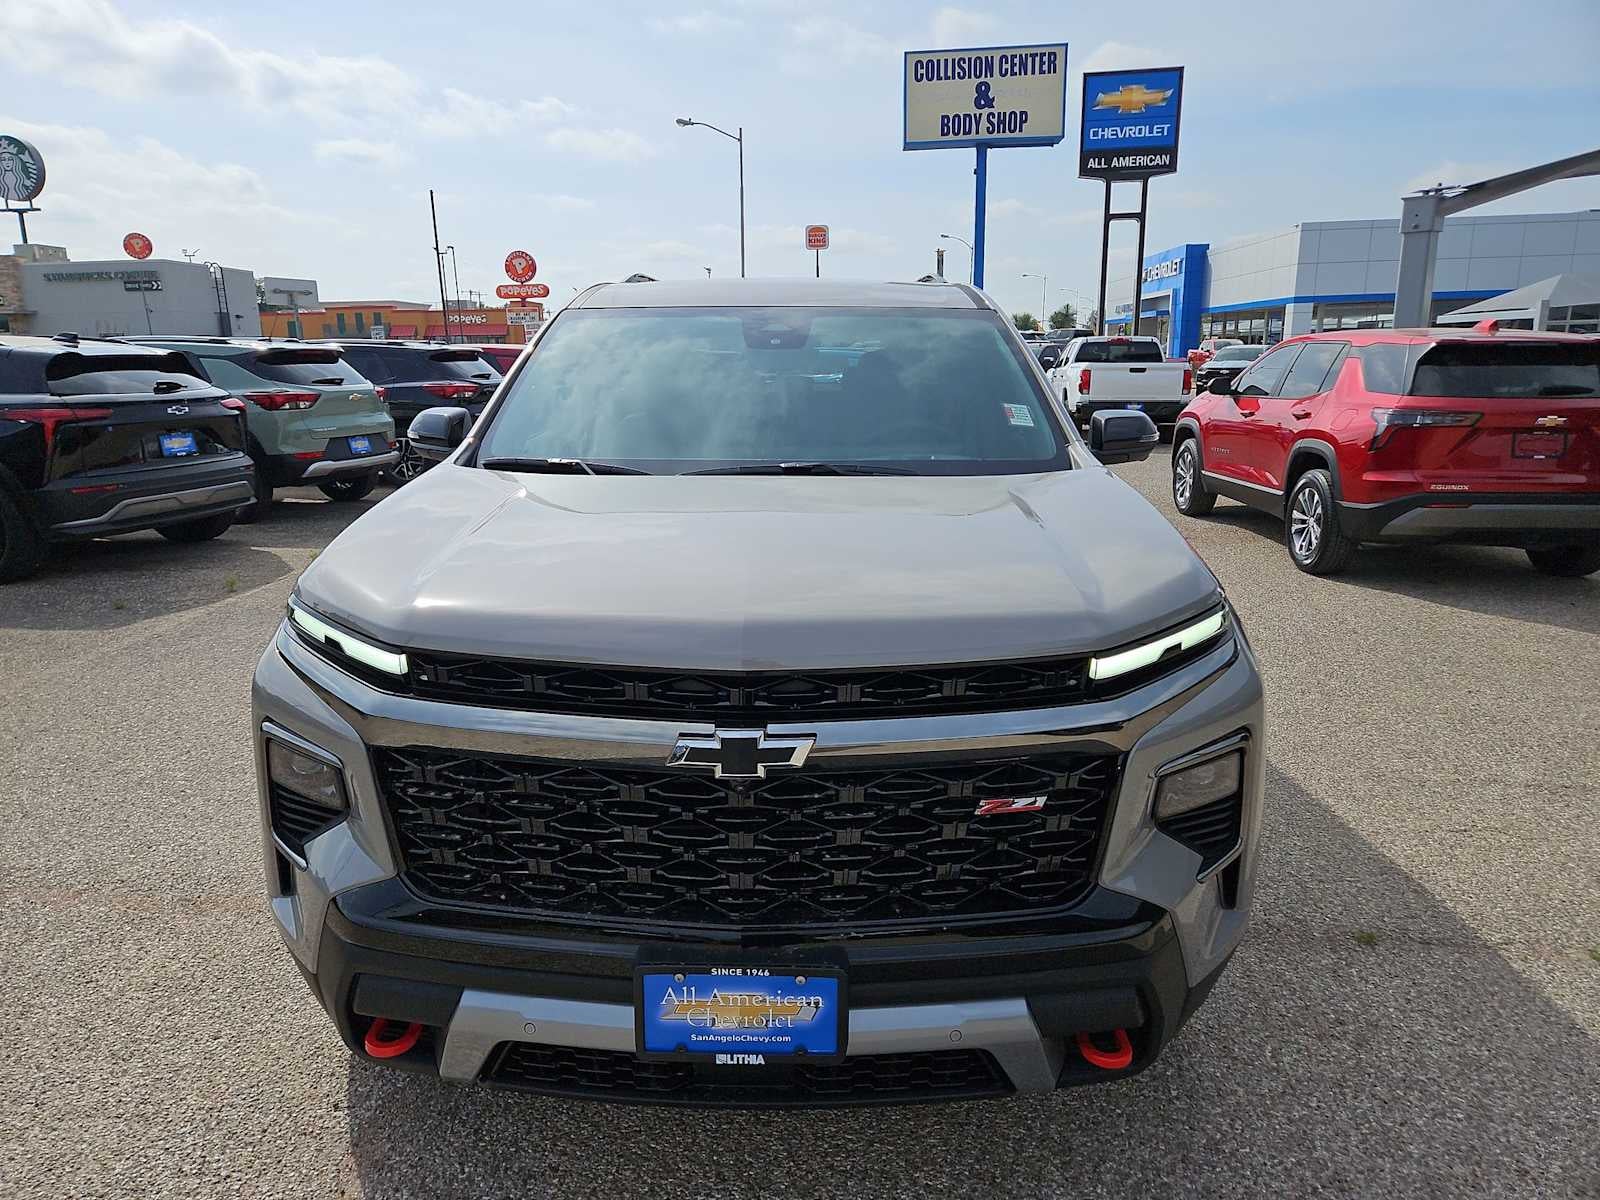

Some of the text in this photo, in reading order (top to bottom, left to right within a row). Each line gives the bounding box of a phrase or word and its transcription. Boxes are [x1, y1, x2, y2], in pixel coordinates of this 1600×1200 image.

[913, 51, 1058, 82] COLLISION CENTER
[974, 81, 995, 109] &
[940, 110, 1028, 137] BODY SHOP
[1089, 124, 1171, 140] CHEVROLET
[1087, 154, 1170, 168] ALL AMERICAN
[1147, 258, 1184, 281] CHEVROLET
[500, 285, 544, 297] POPEYES
[448, 314, 487, 324] POPEYES
[711, 967, 770, 977] SINCE 1946
[659, 986, 825, 1008] All American
[686, 1007, 794, 1028] Chevrolet
[691, 1033, 791, 1043] SanAngeloChevy.com
[726, 1053, 766, 1065] LITHIA
